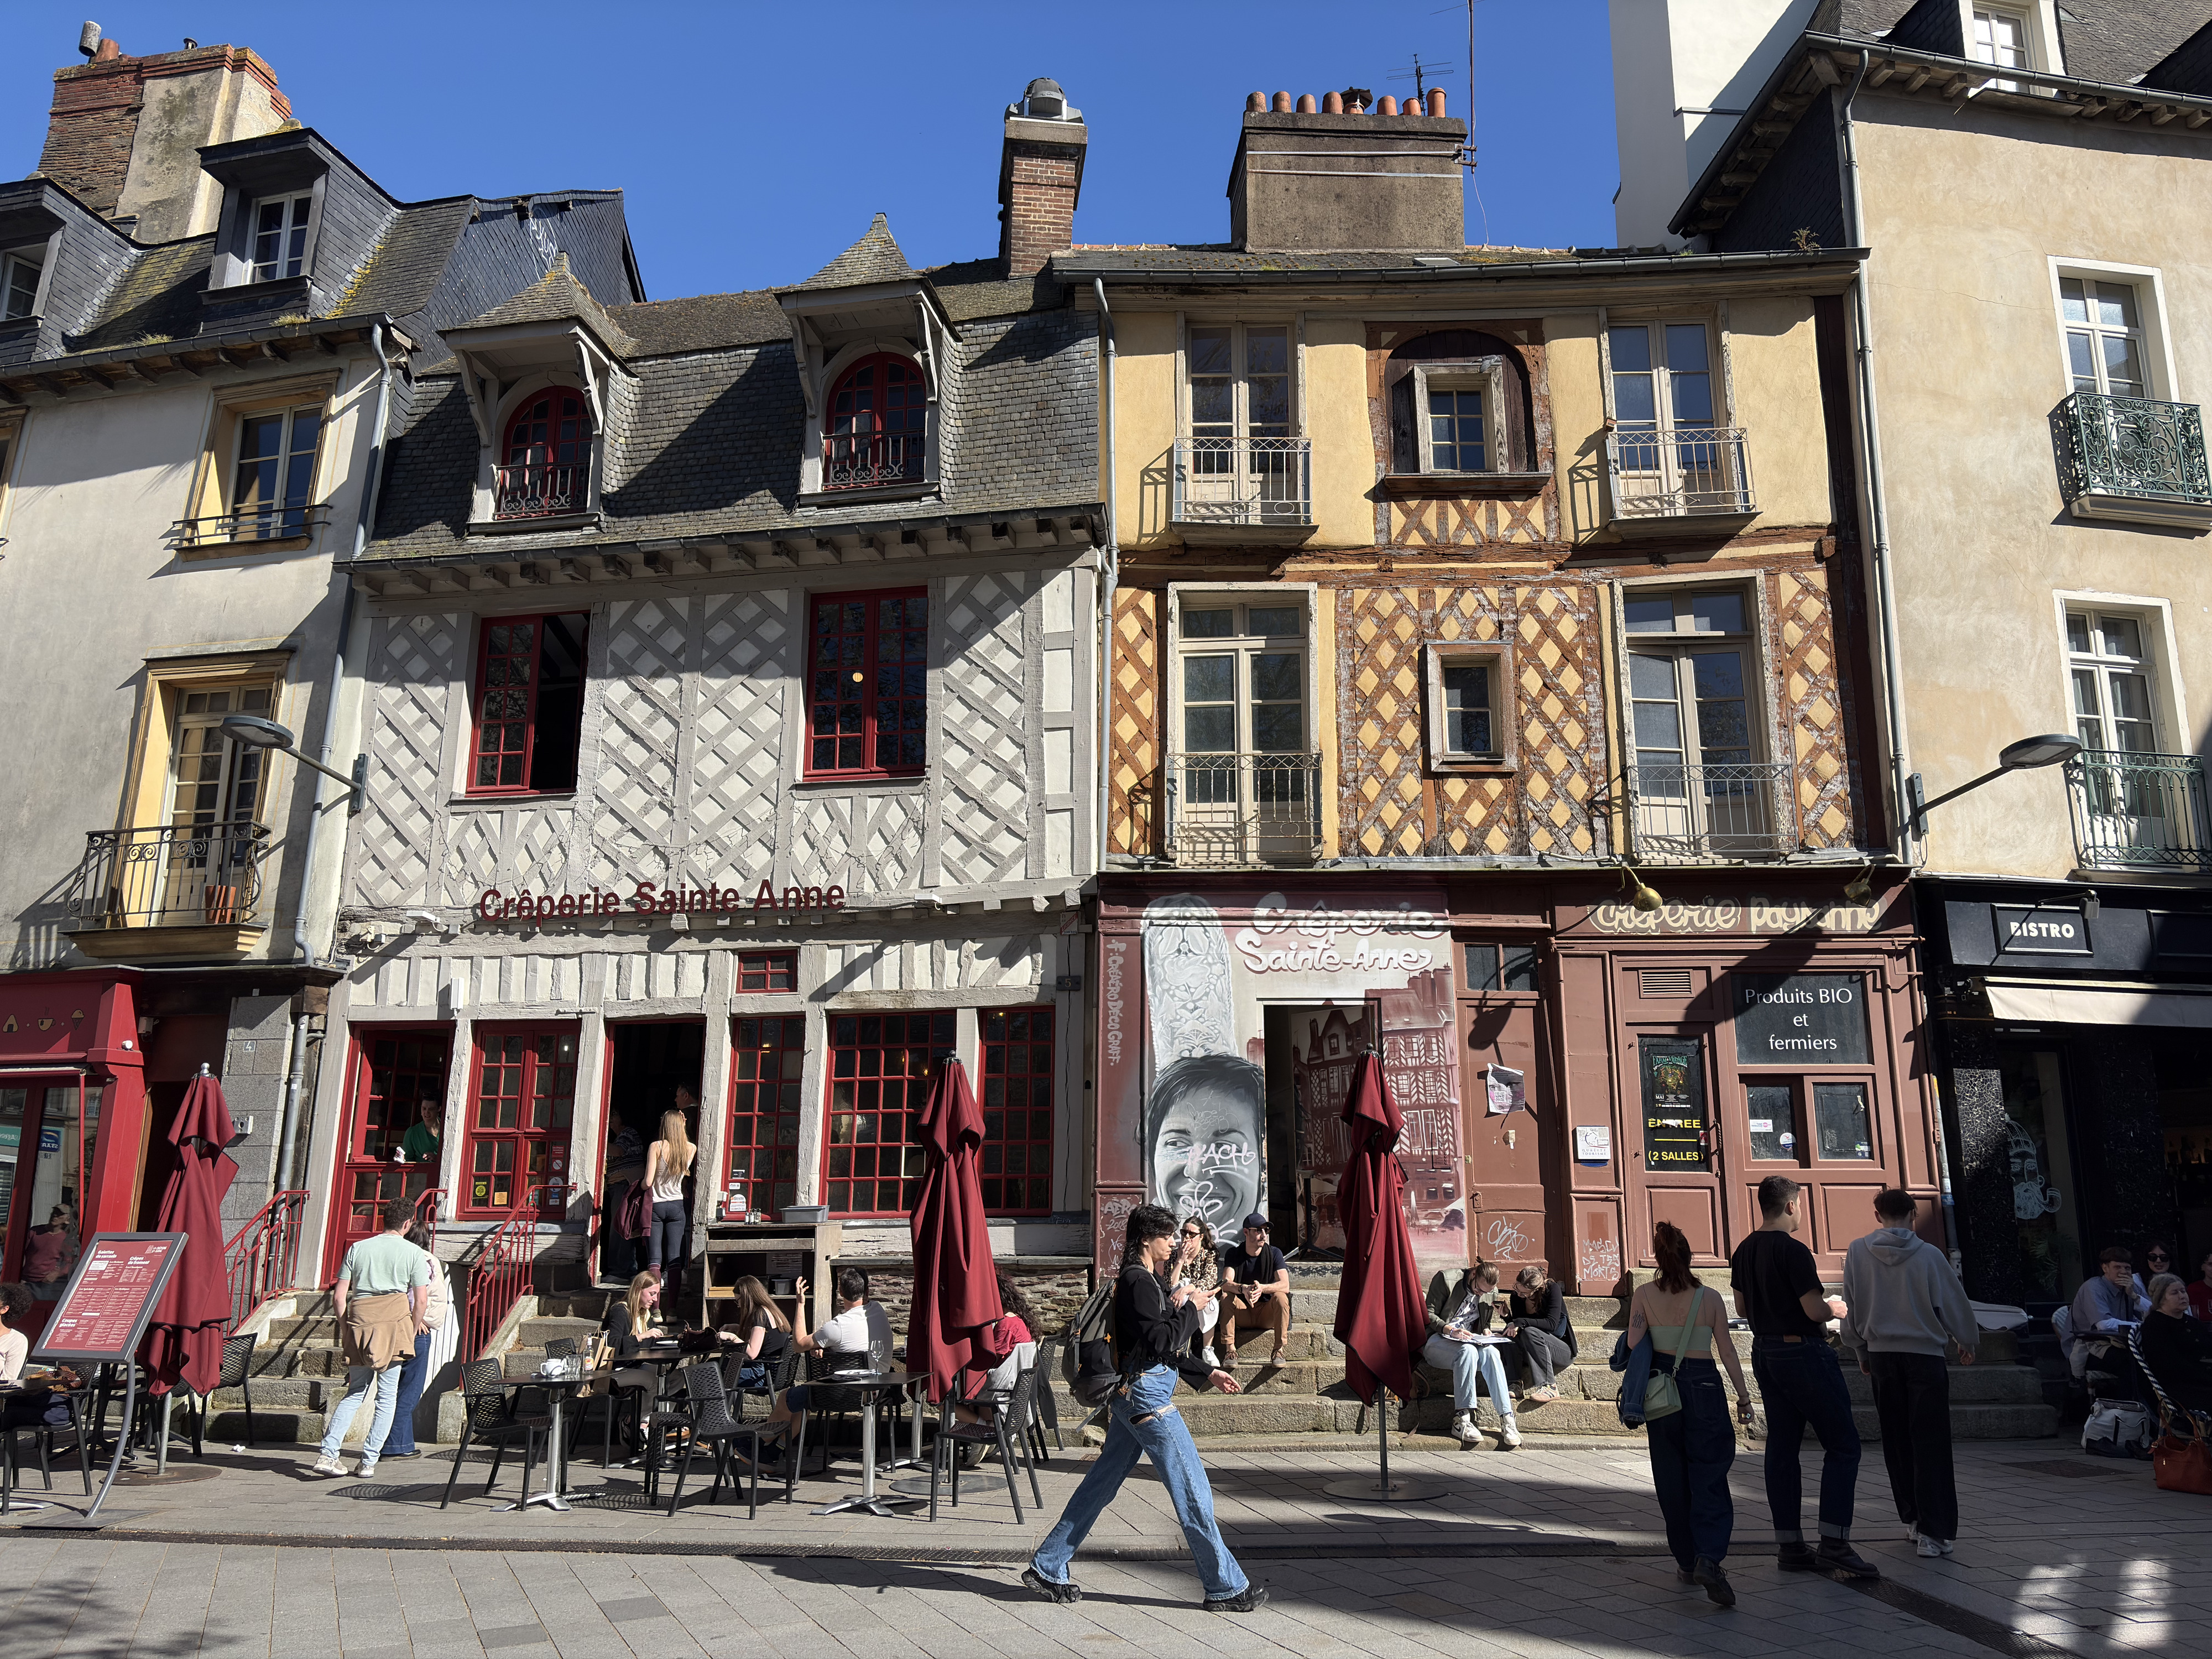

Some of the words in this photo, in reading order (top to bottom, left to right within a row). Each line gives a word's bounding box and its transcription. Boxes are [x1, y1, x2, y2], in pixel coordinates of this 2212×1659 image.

[480, 888, 620, 926] Crêperie
[635, 881, 739, 915] Sainte
[753, 879, 846, 911] Anne
[1062, 915, 1077, 931] LICENCE
[1251, 891, 1447, 945] Crêperie
[2010, 922, 2075, 938] BISTRO
[1065, 978, 1071, 988] 5
[1745, 988, 1814, 1004] Produits
[1819, 988, 1853, 1004] BIO
[1793, 1014, 1809, 1027] et
[246, 1041, 252, 1051] 4
[1769, 1034, 1837, 1050] fermiers
[1652, 1055, 1668, 1067] FARM
[1668, 1055, 1688, 1067] VILLAGE
[1648, 1118, 1701, 1128] ENREE
